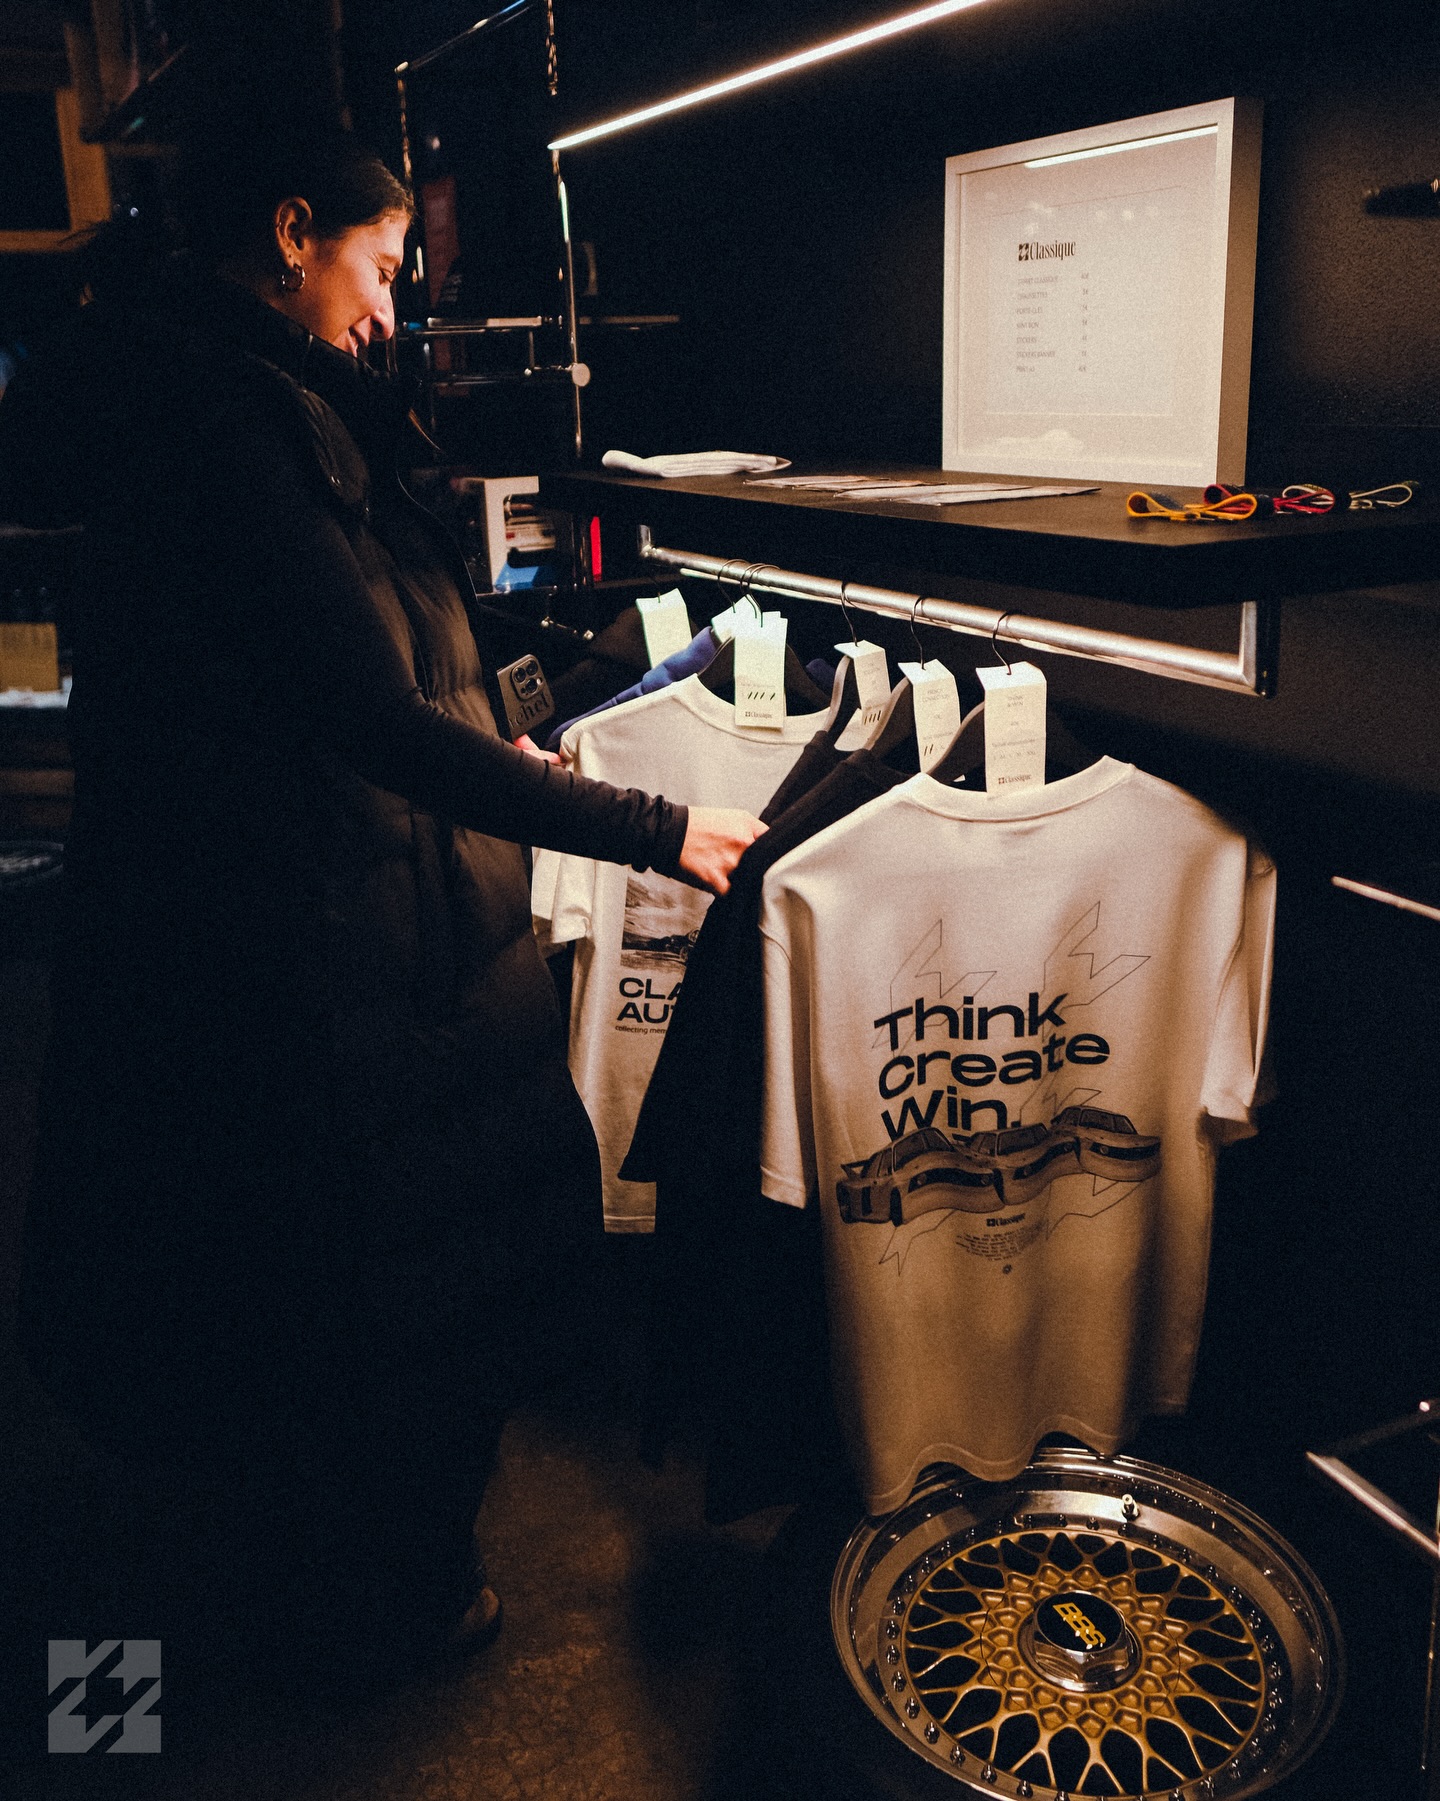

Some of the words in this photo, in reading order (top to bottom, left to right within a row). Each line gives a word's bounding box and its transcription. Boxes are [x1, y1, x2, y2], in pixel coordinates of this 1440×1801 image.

[1030, 240, 1076, 260] Classique
[616, 1001, 675, 1024] AU
[873, 992, 1069, 1051] Think
[615, 1025, 648, 1035] collecting
[1052, 1602, 1107, 1650] BBS
